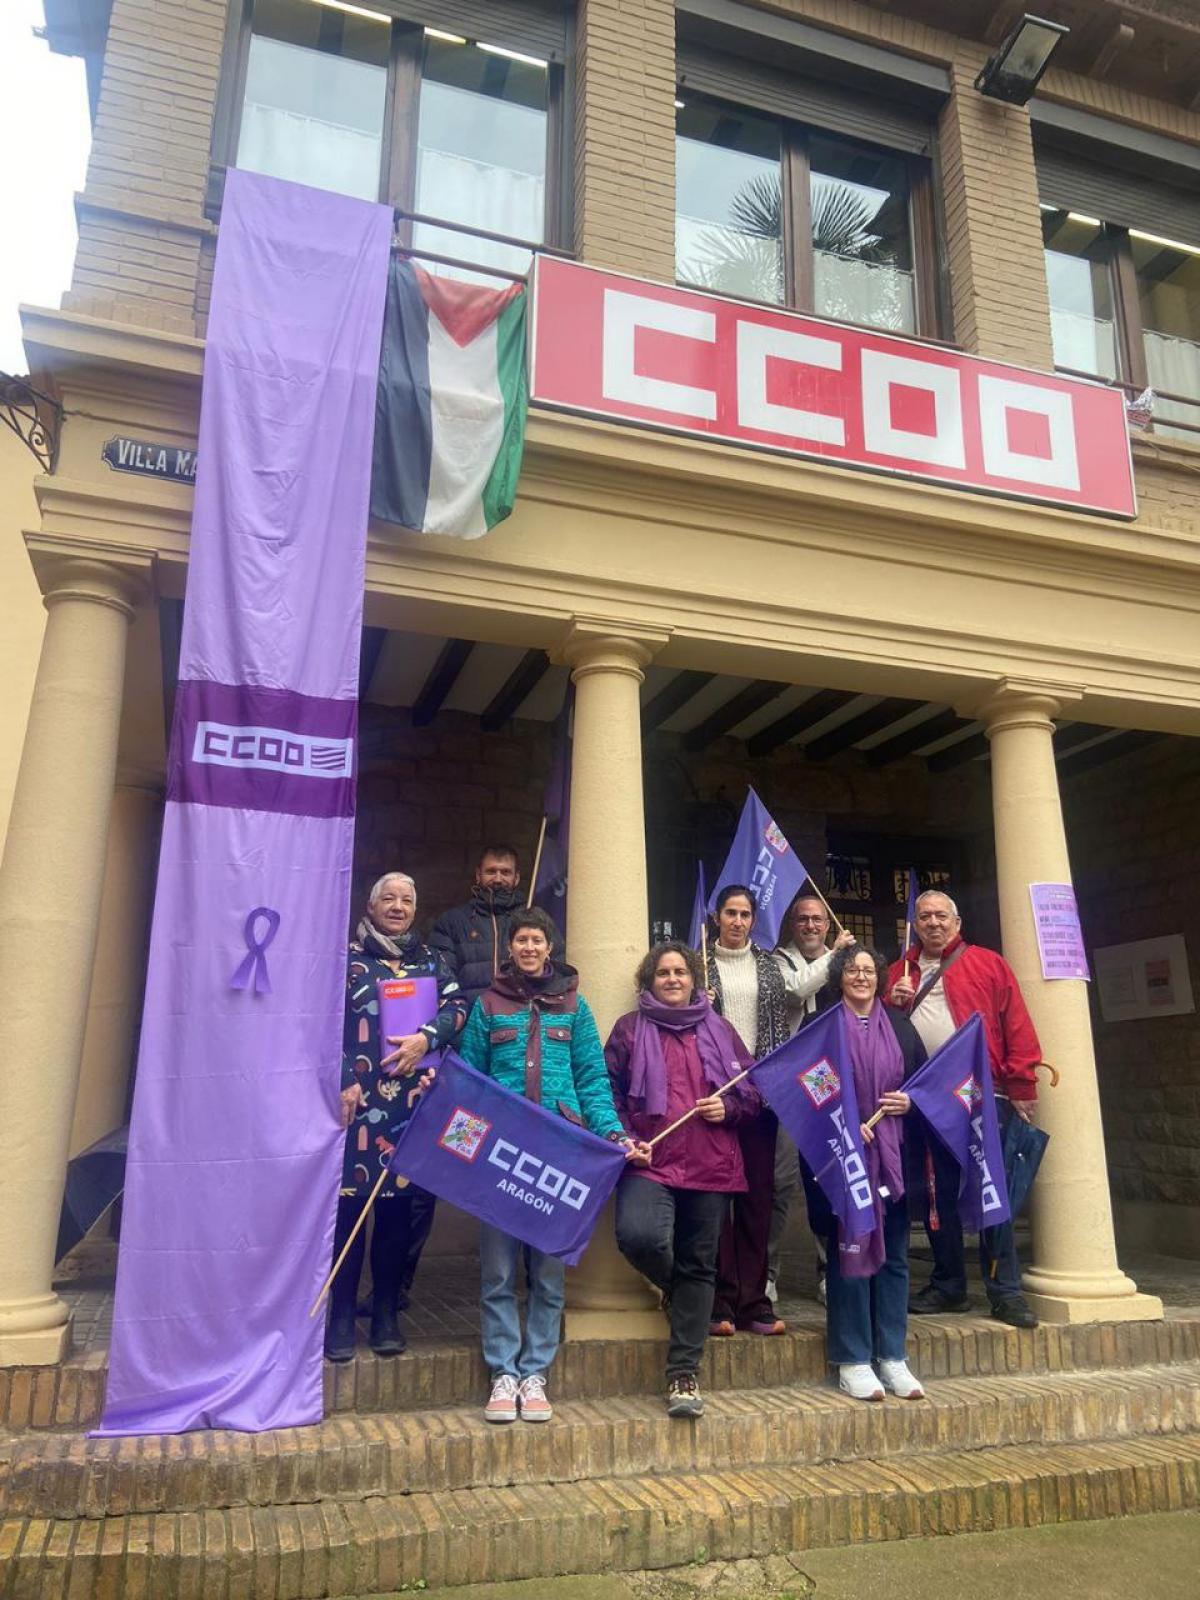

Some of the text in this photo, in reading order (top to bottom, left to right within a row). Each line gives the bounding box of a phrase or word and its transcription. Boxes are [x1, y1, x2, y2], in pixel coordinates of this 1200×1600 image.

[603, 288, 1081, 492] CCOO
[118, 439, 198, 476] VILLA MA
[203, 731, 305, 766] CCOO
[488, 1138, 591, 1211] CCOO
[496, 1178, 554, 1216] ARAGÓN
